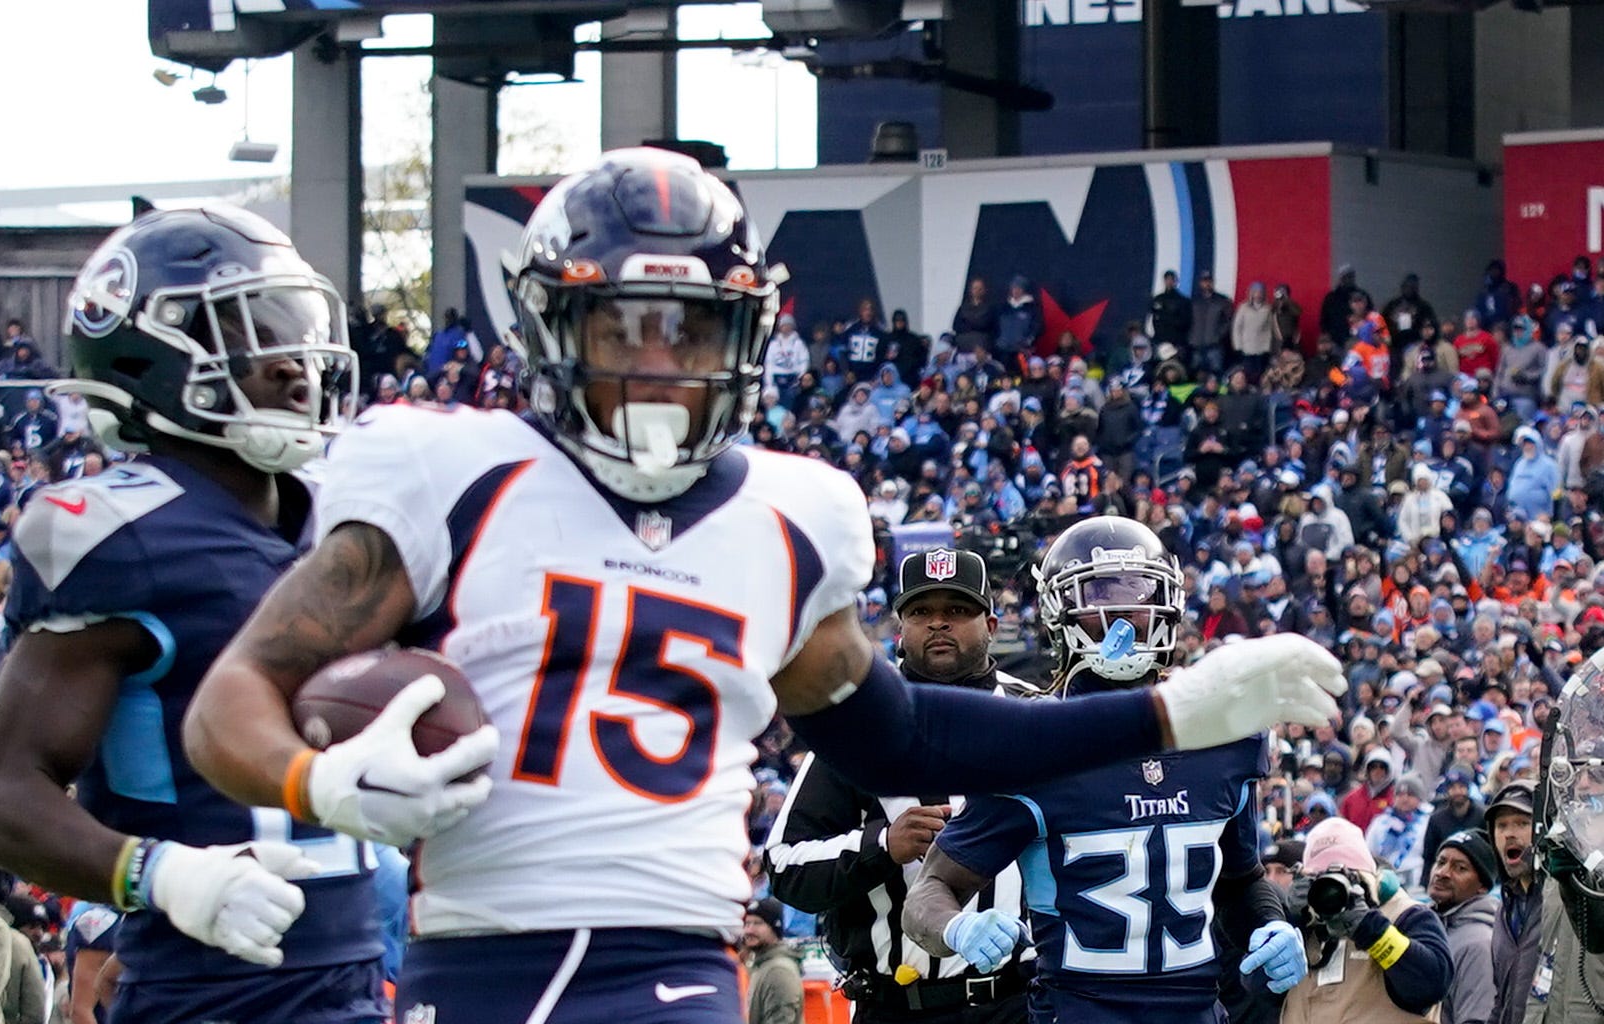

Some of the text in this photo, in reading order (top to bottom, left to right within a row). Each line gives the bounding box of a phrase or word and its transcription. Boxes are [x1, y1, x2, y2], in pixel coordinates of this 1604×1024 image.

[602, 558, 701, 587] BRONCOS
[928, 563, 953, 575] NFL
[512, 571, 748, 805] 15
[1124, 790, 1190, 821] TITANS
[1061, 823, 1229, 974] 39
